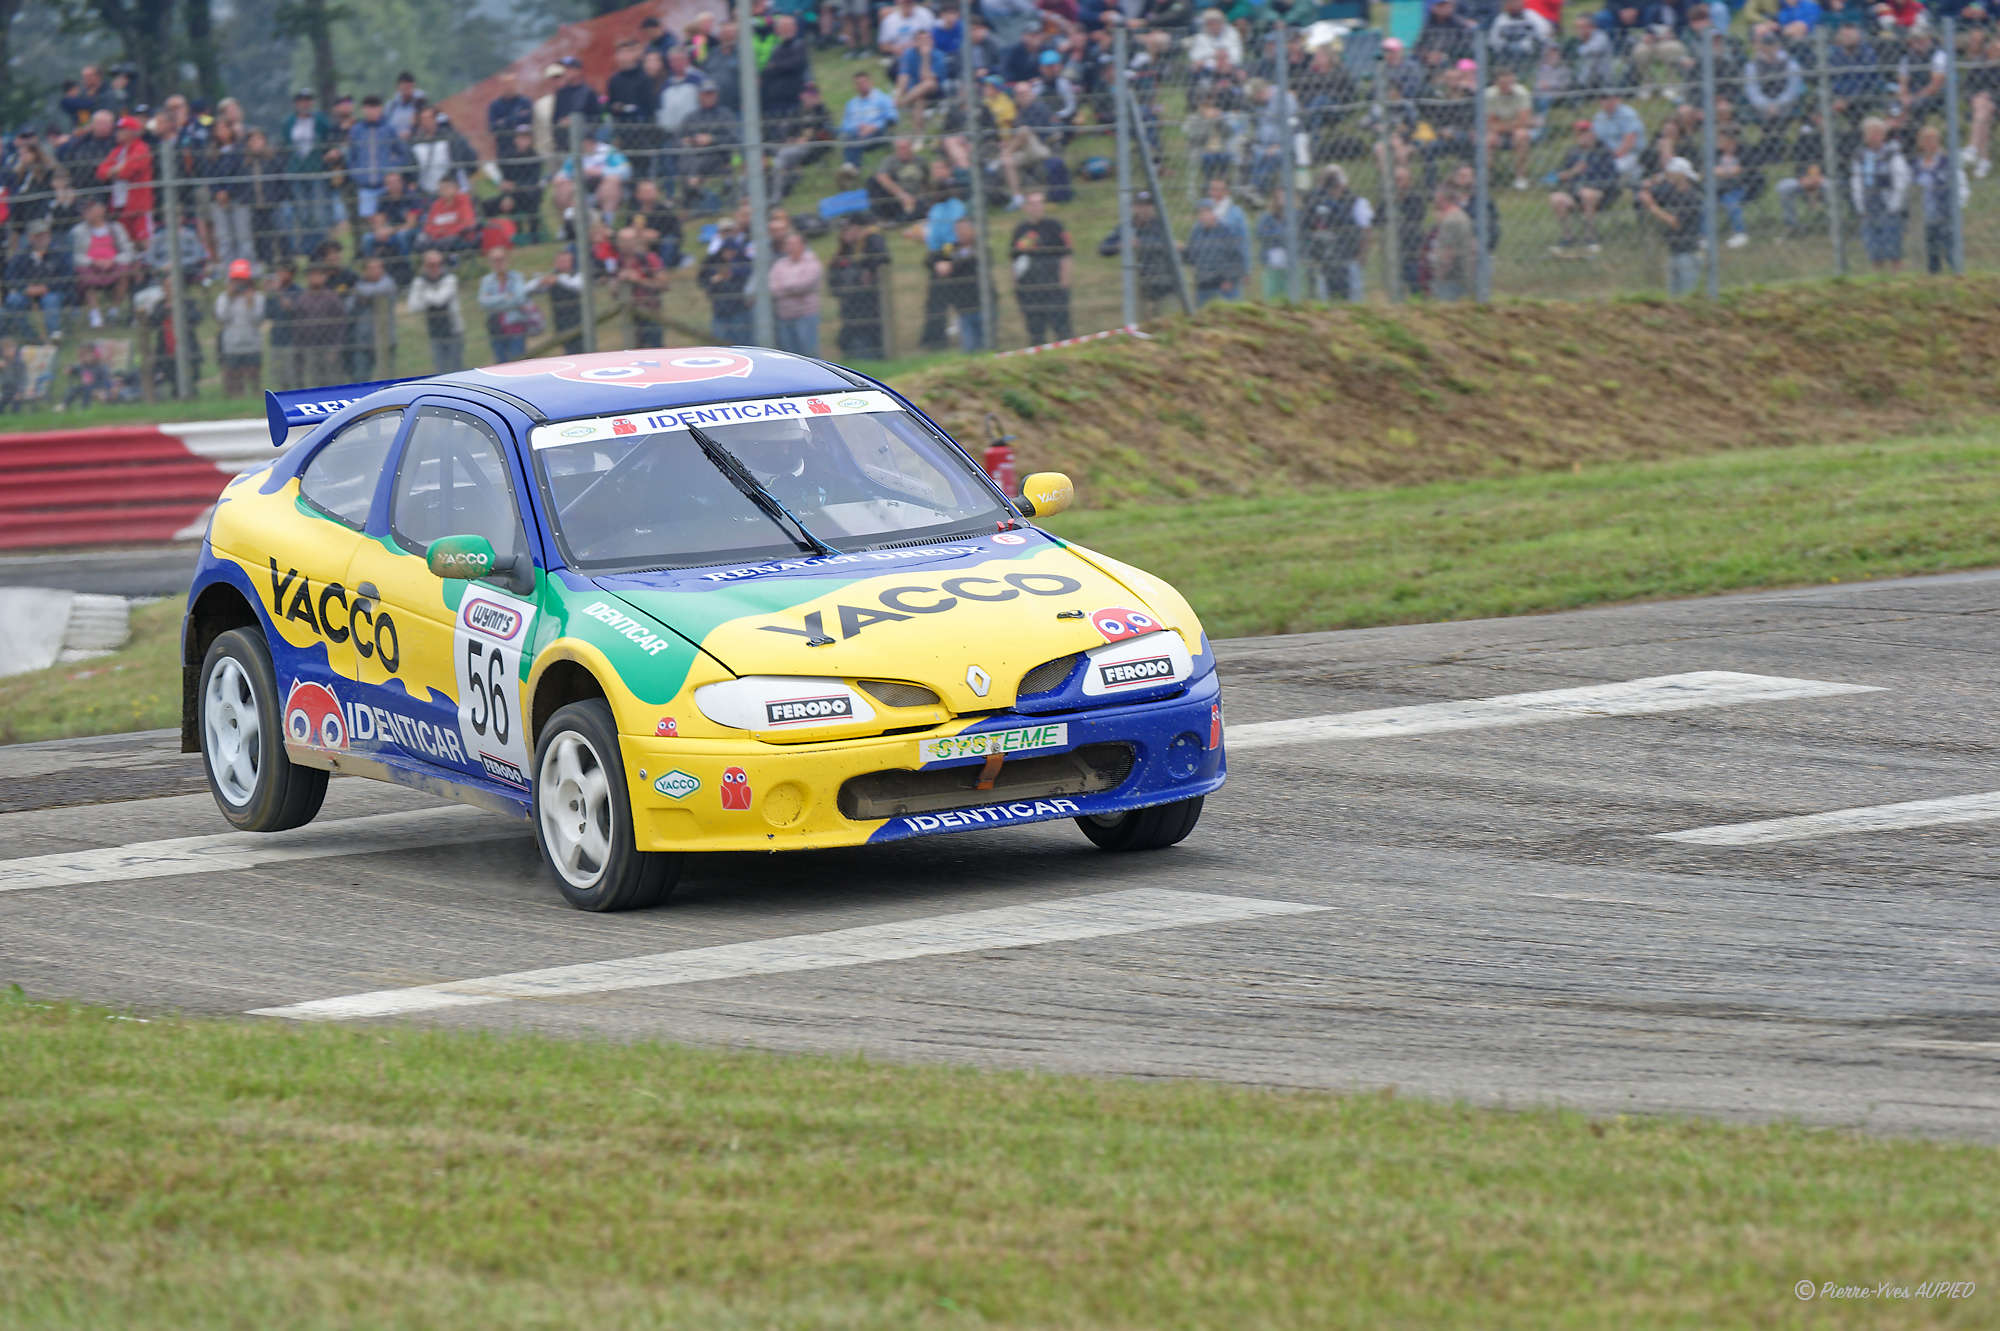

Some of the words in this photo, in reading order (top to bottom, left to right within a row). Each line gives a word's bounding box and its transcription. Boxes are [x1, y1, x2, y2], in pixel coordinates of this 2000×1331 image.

[647, 402, 801, 429] IDENTICAR
[438, 553, 488, 565] YACCO
[702, 552, 862, 582] RENAULT
[867, 545, 991, 561] DREUX
[269, 556, 400, 674] YACCO
[755, 573, 1082, 641] YACCO
[582, 601, 670, 656] IDENTICAR
[1105, 660, 1170, 683] FERODO
[466, 638, 509, 746] 56
[771, 699, 847, 720] FERODO
[346, 701, 467, 766] IDENTICAR
[935, 725, 1060, 759] SYSTEME
[482, 757, 523, 784] FERODO
[658, 779, 695, 790] YACCO
[903, 799, 1080, 832] IDENTICAR
